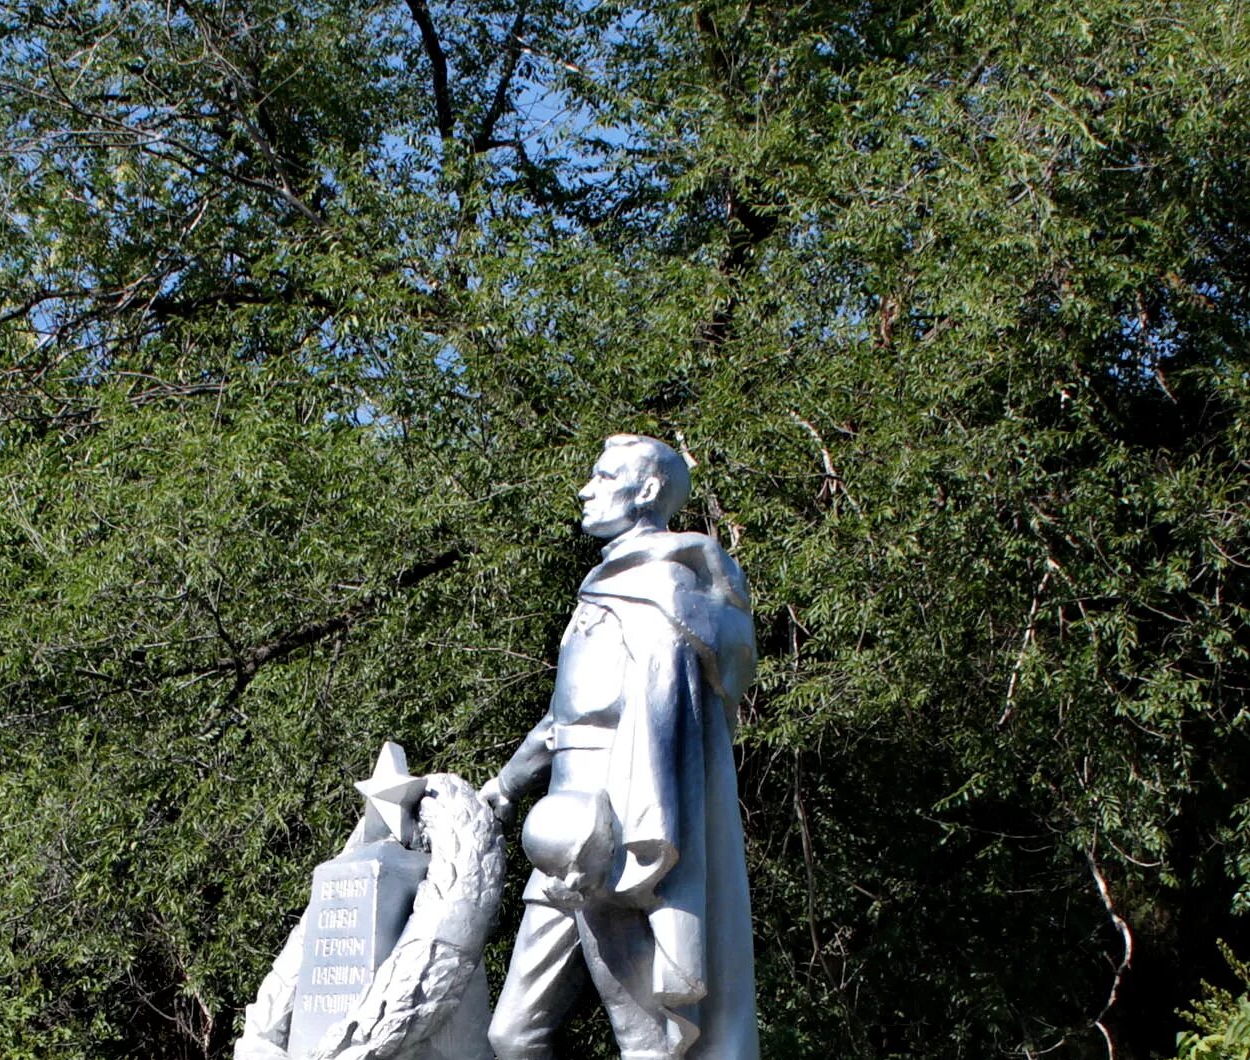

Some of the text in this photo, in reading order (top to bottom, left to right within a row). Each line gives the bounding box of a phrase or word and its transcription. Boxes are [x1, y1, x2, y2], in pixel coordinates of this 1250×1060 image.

[321, 879, 368, 900] ВЕЧНАЯ
[318, 908, 358, 928] СЛАВА
[314, 937, 365, 957] ГЕРОЯМ
[311, 966, 366, 985] ПАВШИМ
